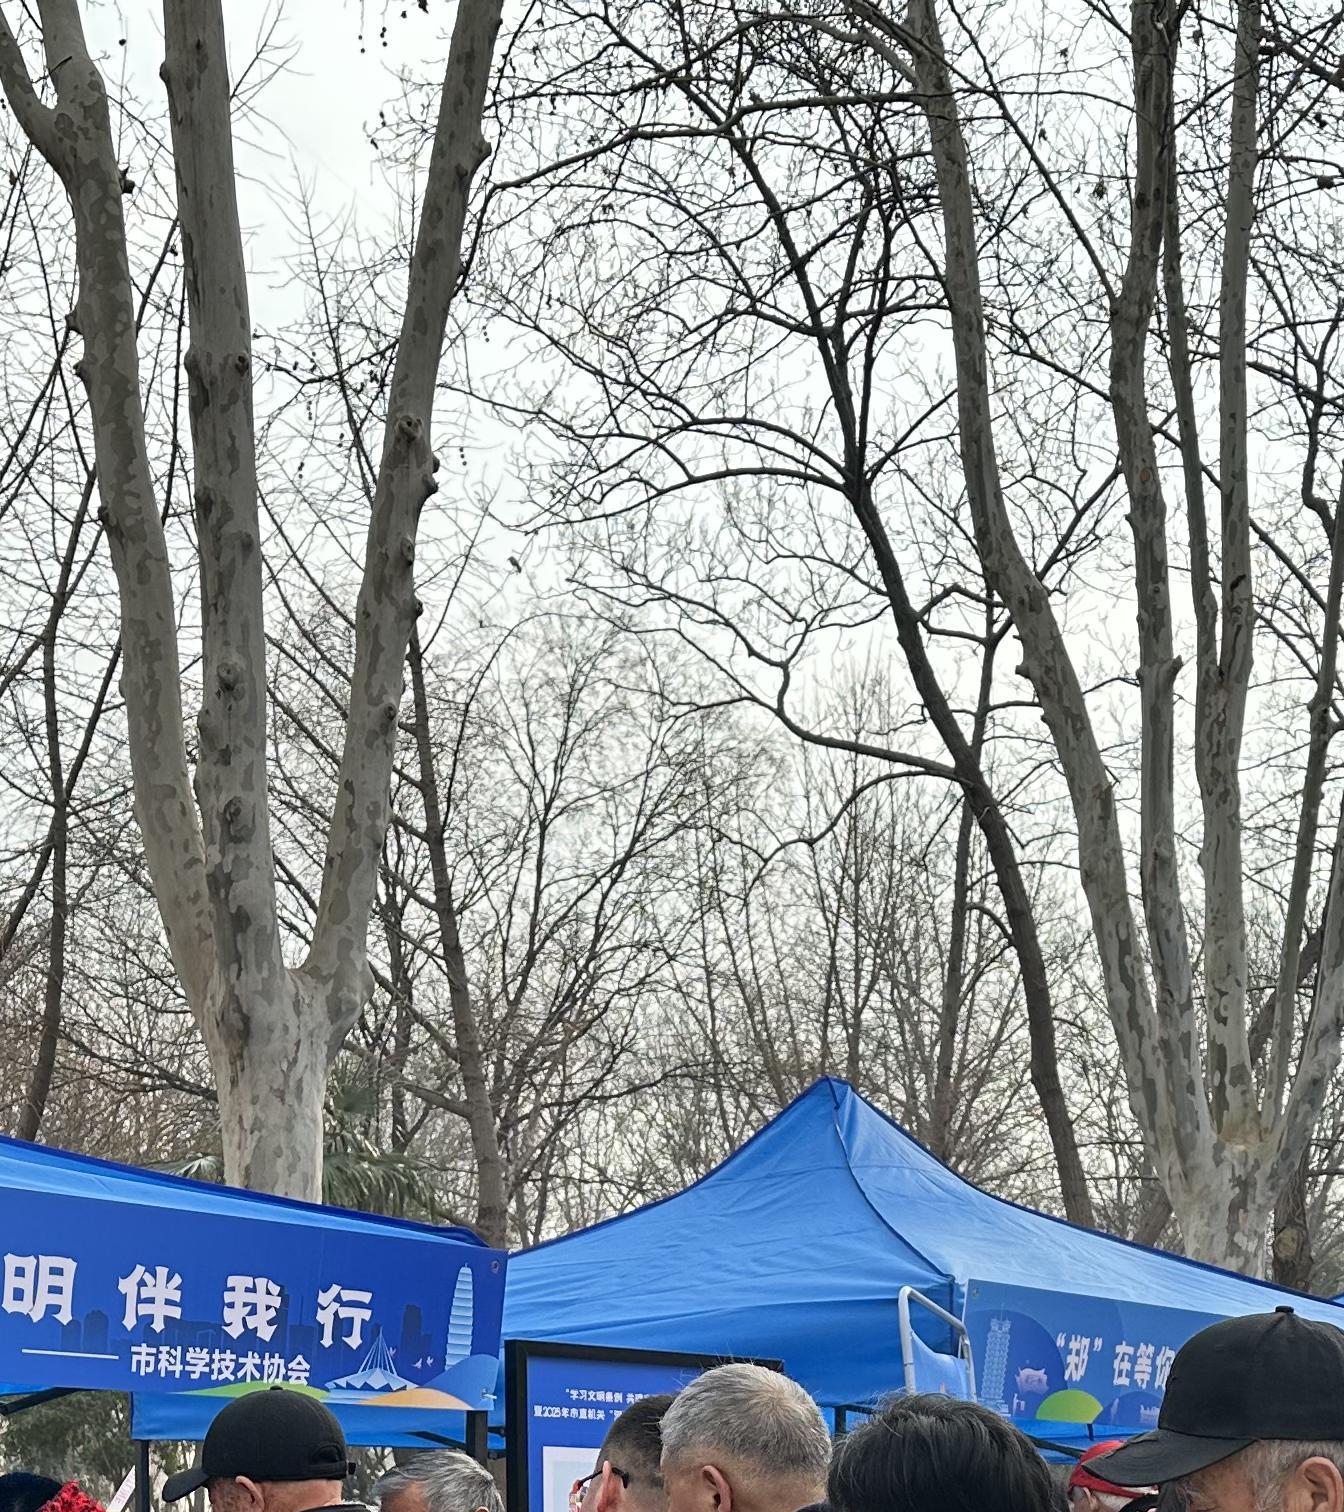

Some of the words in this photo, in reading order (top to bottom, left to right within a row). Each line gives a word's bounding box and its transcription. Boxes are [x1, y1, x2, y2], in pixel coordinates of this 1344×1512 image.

[130, 1343, 310, 1386] 市科学技术协会
